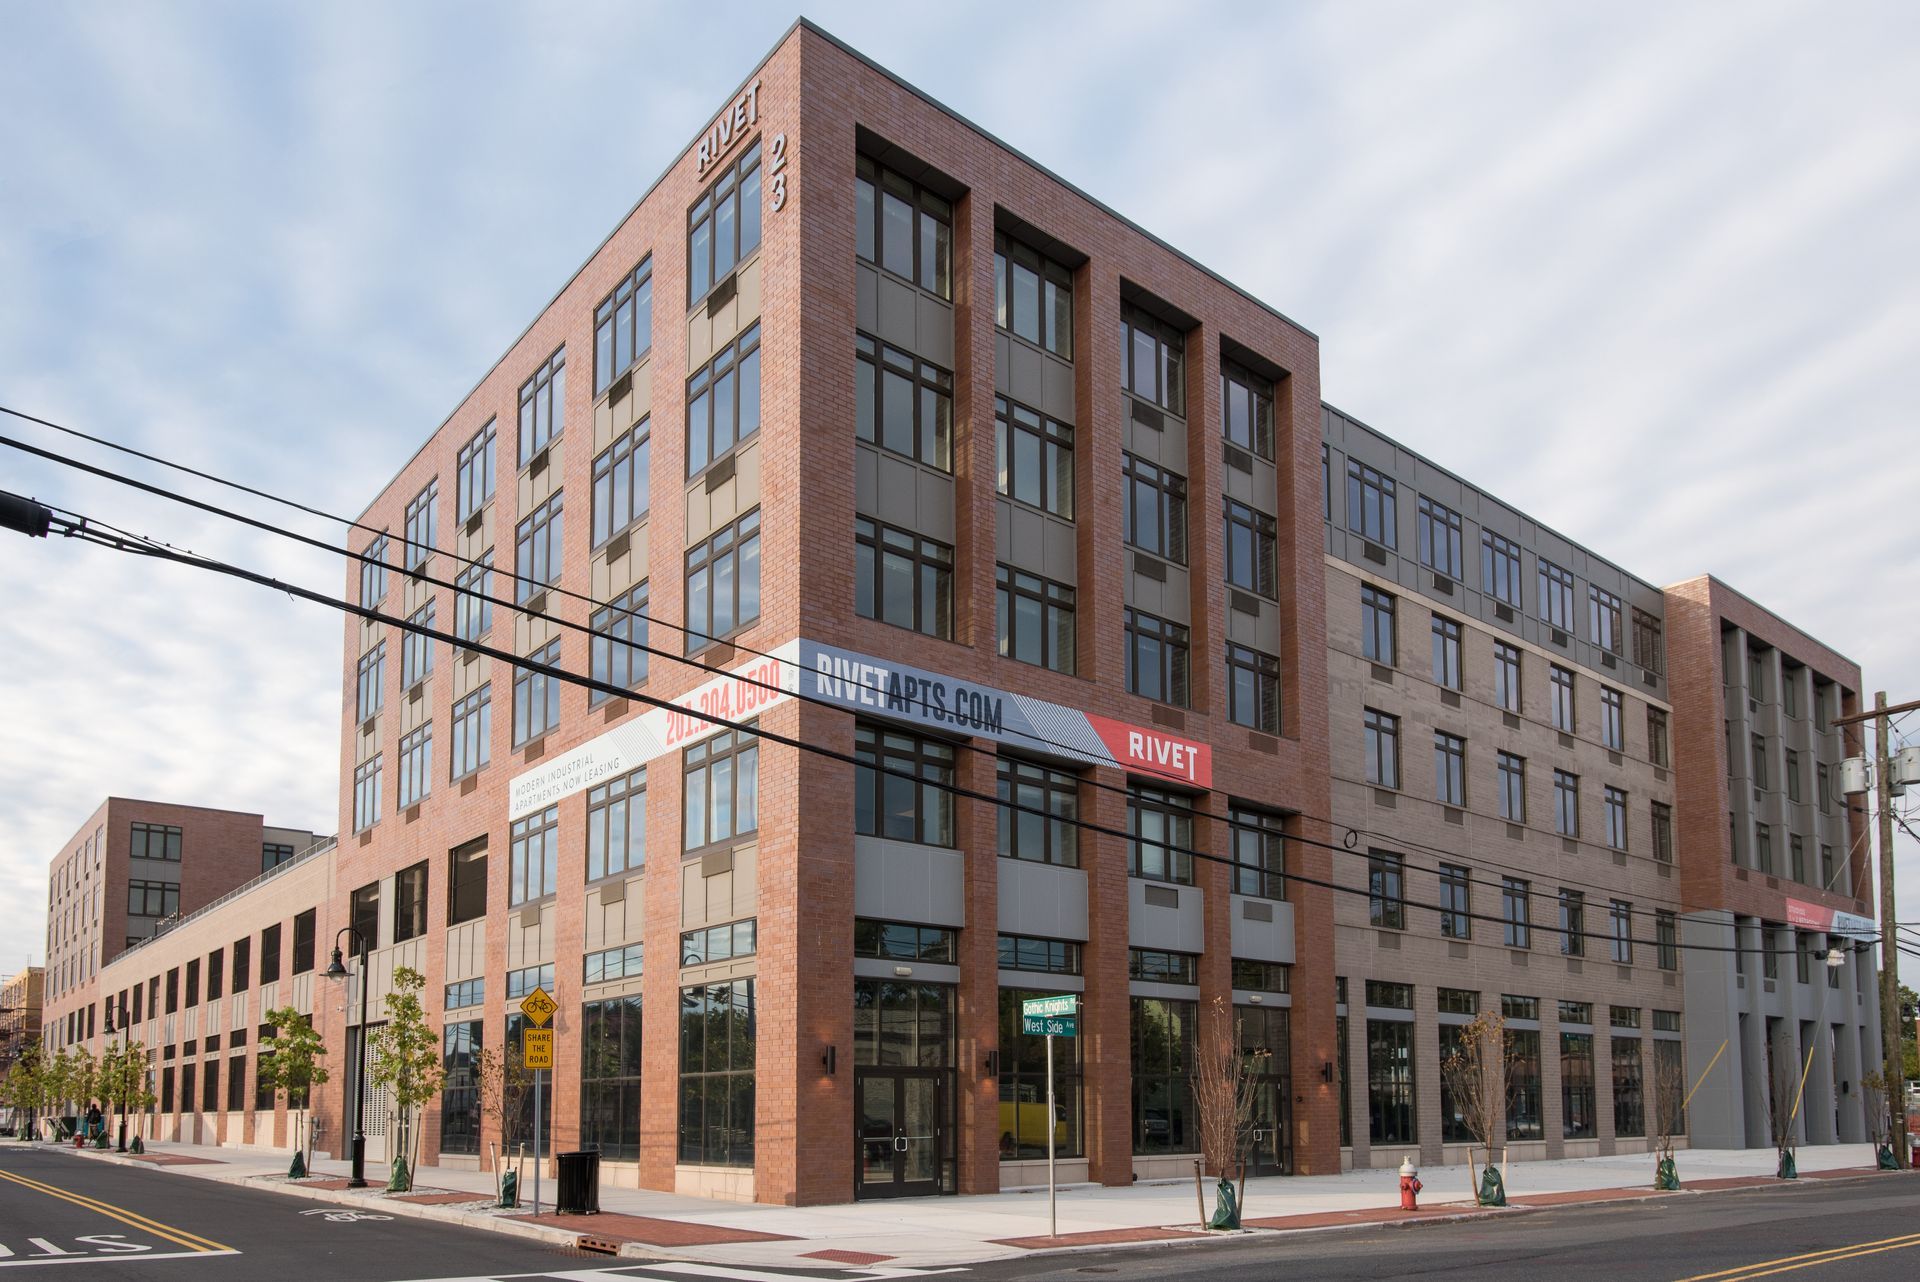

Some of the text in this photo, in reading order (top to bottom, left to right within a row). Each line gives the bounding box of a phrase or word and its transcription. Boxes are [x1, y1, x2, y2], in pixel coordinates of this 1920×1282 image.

[696, 79, 762, 173] RIVET
[666, 658, 780, 746] 201.204.0500
[817, 652, 1003, 735] RIVETAPTS.COM
[515, 753, 594, 797] MODERN INDUSTRIAL
[1129, 731, 1198, 781] RIVET
[514, 757, 620, 812] APARTMENTS NOW LEASING
[1023, 1002, 1044, 1015] Gothic
[1044, 999, 1069, 1015] Knights
[1024, 1018, 1075, 1034] West Side Ave
[527, 1034, 551, 1042] SHARE
[533, 1044, 546, 1053] THE
[0, 1234, 153, 1257] ST
